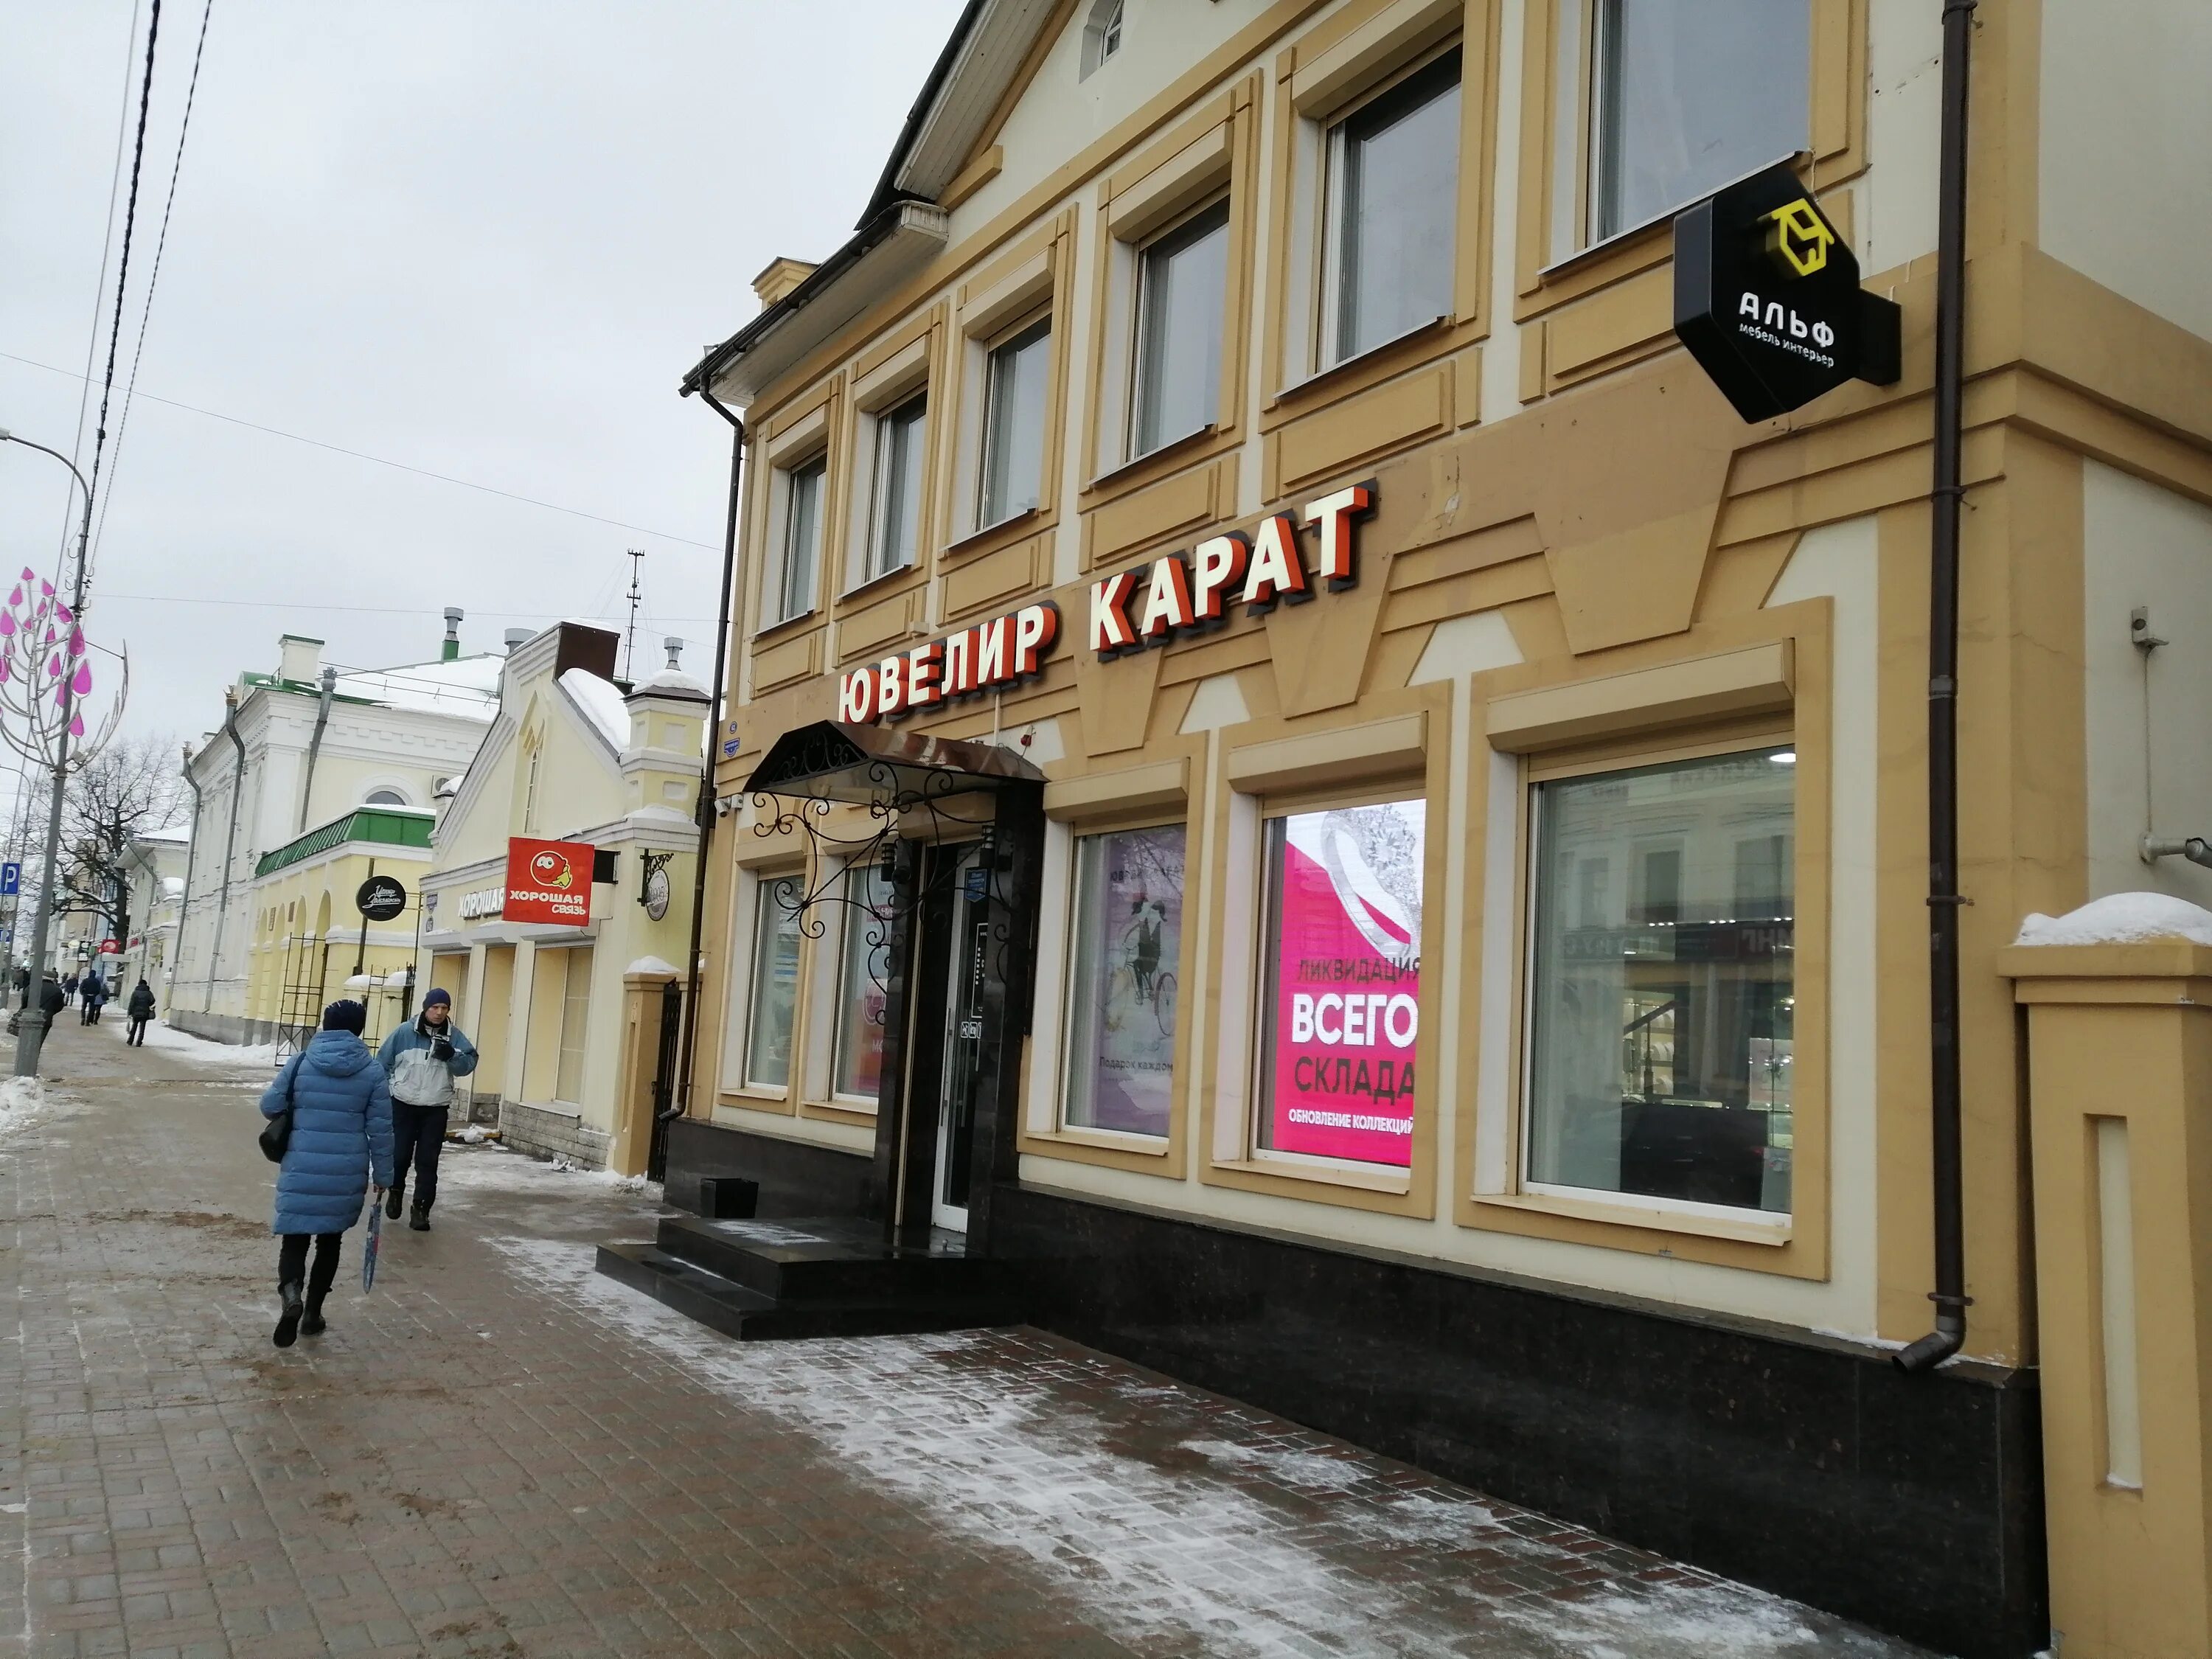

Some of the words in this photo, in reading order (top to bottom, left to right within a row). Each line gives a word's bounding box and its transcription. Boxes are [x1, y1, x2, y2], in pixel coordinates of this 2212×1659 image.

[1739, 291, 1834, 348] АЛЬФ
[1739, 323, 1781, 347] мебель
[1782, 338, 1834, 368] интерьер
[839, 603, 1056, 724] ЮВЕЛИР
[1090, 486, 1368, 651] КАРАТ
[458, 886, 505, 917] ХОРОШАЯ
[509, 890, 583, 904] ХОРОШАЯ
[552, 904, 586, 915] СВЯЗЬ
[1298, 956, 1420, 984] ЛИКВИДАЦИЯ
[1292, 993, 1419, 1048] ВСЕГО
[1294, 1056, 1415, 1105] СКЛАДА
[1288, 1108, 1352, 1128] ОБНОВЛЕНИЕ
[1352, 1114, 1413, 1135] КОЛЛЕКЦИЙ
